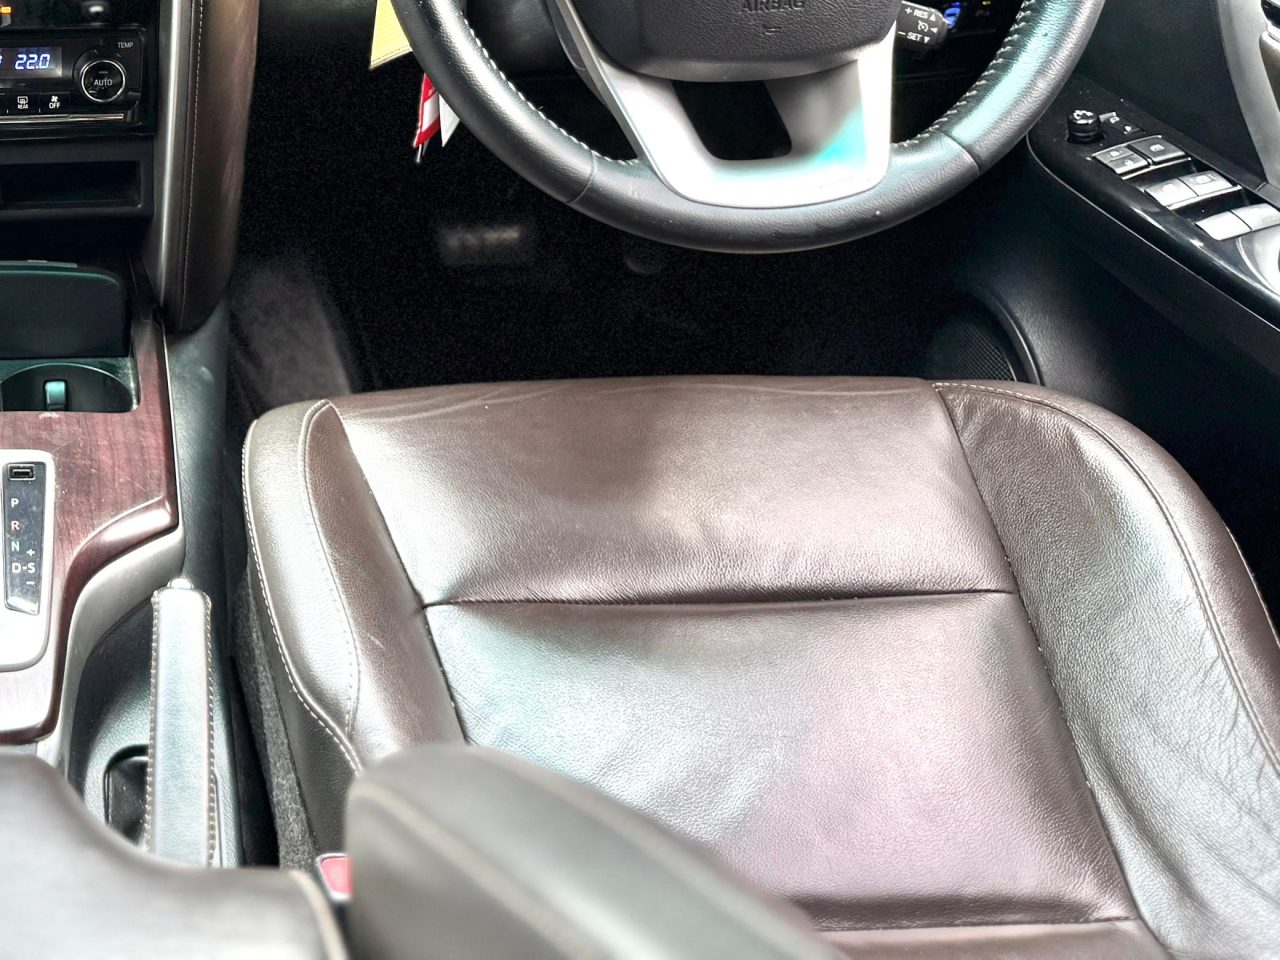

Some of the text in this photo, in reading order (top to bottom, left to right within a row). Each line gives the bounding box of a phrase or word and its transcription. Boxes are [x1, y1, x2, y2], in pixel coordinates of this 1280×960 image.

[913, 9, 928, 19] RES
[907, 32, 921, 41] SET
[15, 54, 50, 70] 22.0
[11, 498, 19, 508] P
[11, 521, 20, 530] R
[12, 541, 20, 551] N
